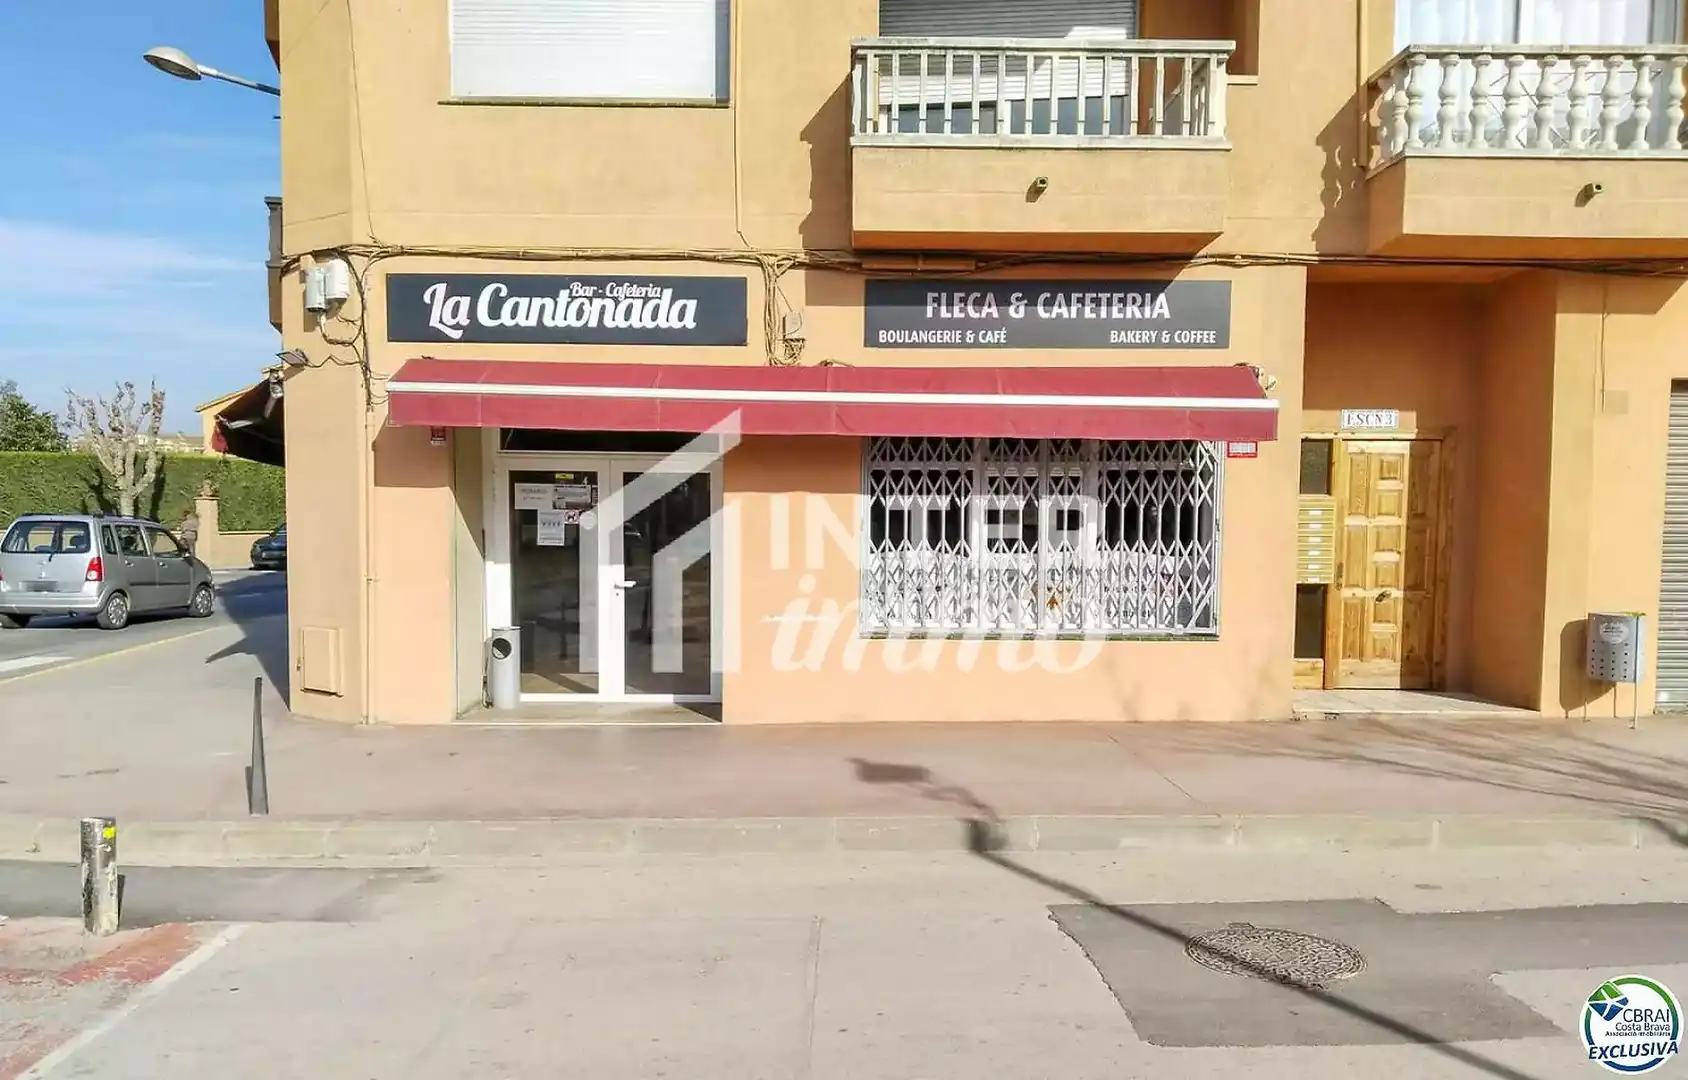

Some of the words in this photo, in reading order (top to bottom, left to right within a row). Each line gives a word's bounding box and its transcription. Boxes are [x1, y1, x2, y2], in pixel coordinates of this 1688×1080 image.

[570, 282, 597, 297] Bar
[605, 281, 662, 299] Cafeteria
[423, 282, 471, 339] La
[476, 283, 698, 330] Cantonada
[926, 292, 999, 319] FLECA
[1008, 293, 1027, 319] &
[1036, 292, 1171, 319] CAFETERIA
[878, 329, 962, 344] BOULANGERIE
[965, 331, 975, 344] &
[978, 327, 1007, 344] CAFÉ
[1110, 330, 1158, 344] BAKERY
[1161, 331, 1172, 344] &
[1173, 330, 1217, 344] COFFEE
